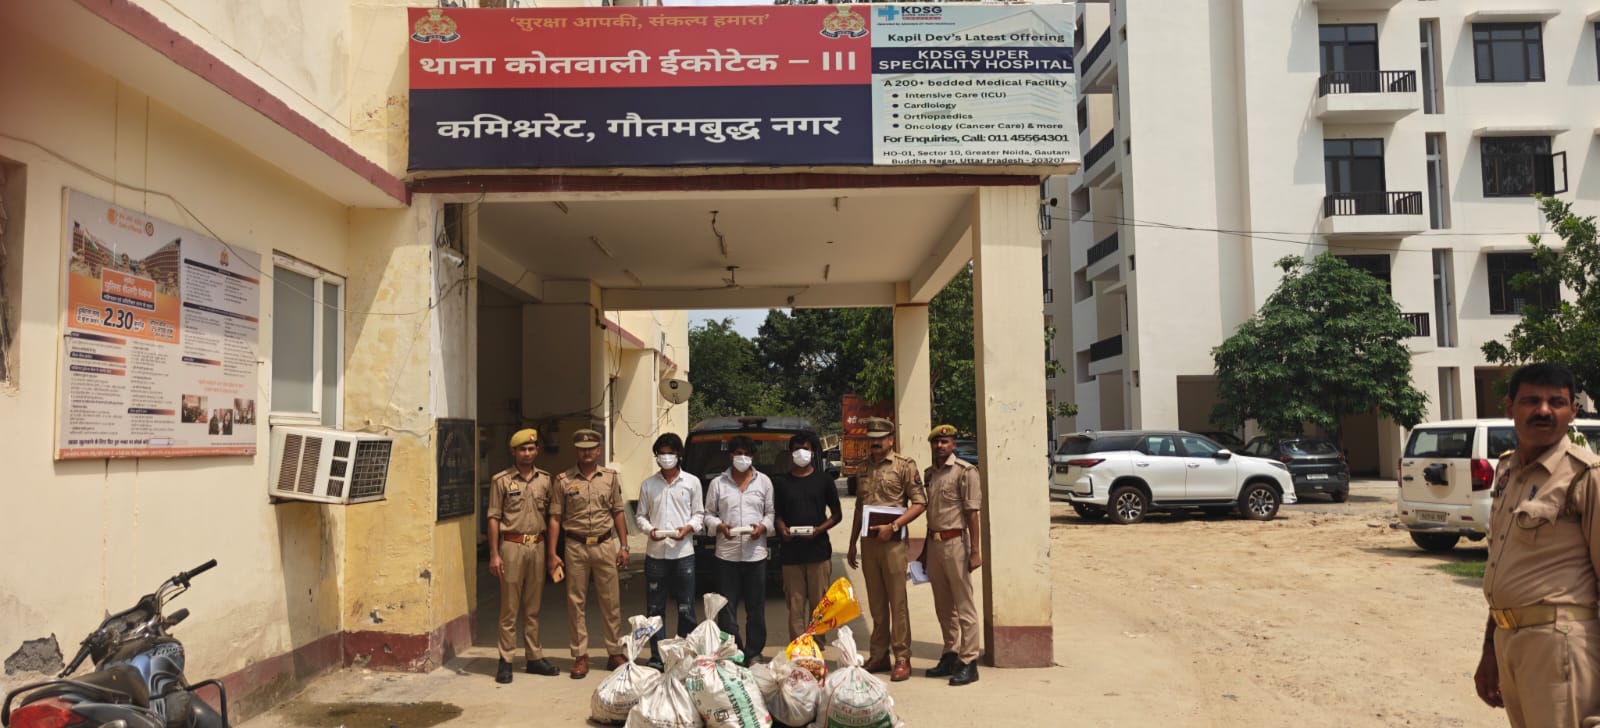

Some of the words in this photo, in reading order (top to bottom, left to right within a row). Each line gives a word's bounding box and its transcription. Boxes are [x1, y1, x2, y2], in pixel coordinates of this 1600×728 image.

[572, 13, 643, 30] आपकी,
[648, 13, 708, 29] संकल्प
[888, 33, 921, 43] Kapil
[1010, 33, 1065, 43] Offering
[918, 50, 966, 60] KDSG
[970, 50, 1029, 60] SUPER
[419, 56, 495, 75] थाना
[504, 50, 650, 75] कोतवाली
[658, 48, 779, 74] ईकोटेक
[821, 51, 857, 71] III
[879, 60, 980, 70] SPECIALITY
[985, 59, 1072, 70] HOSPITAL
[928, 79, 973, 87] bedded
[976, 79, 1022, 87] Medical
[1025, 79, 1067, 88] Facility
[436, 113, 596, 142] कमिश्नरेट,
[606, 112, 761, 144] गौतमबुद्ध
[770, 115, 841, 136] नगर
[883, 135, 902, 143] For
[904, 135, 960, 144] Enquiries,
[962, 134, 986, 142] Call:
[1010, 134, 1069, 142] 45564301
[104, 307, 133, 330] 2.30
